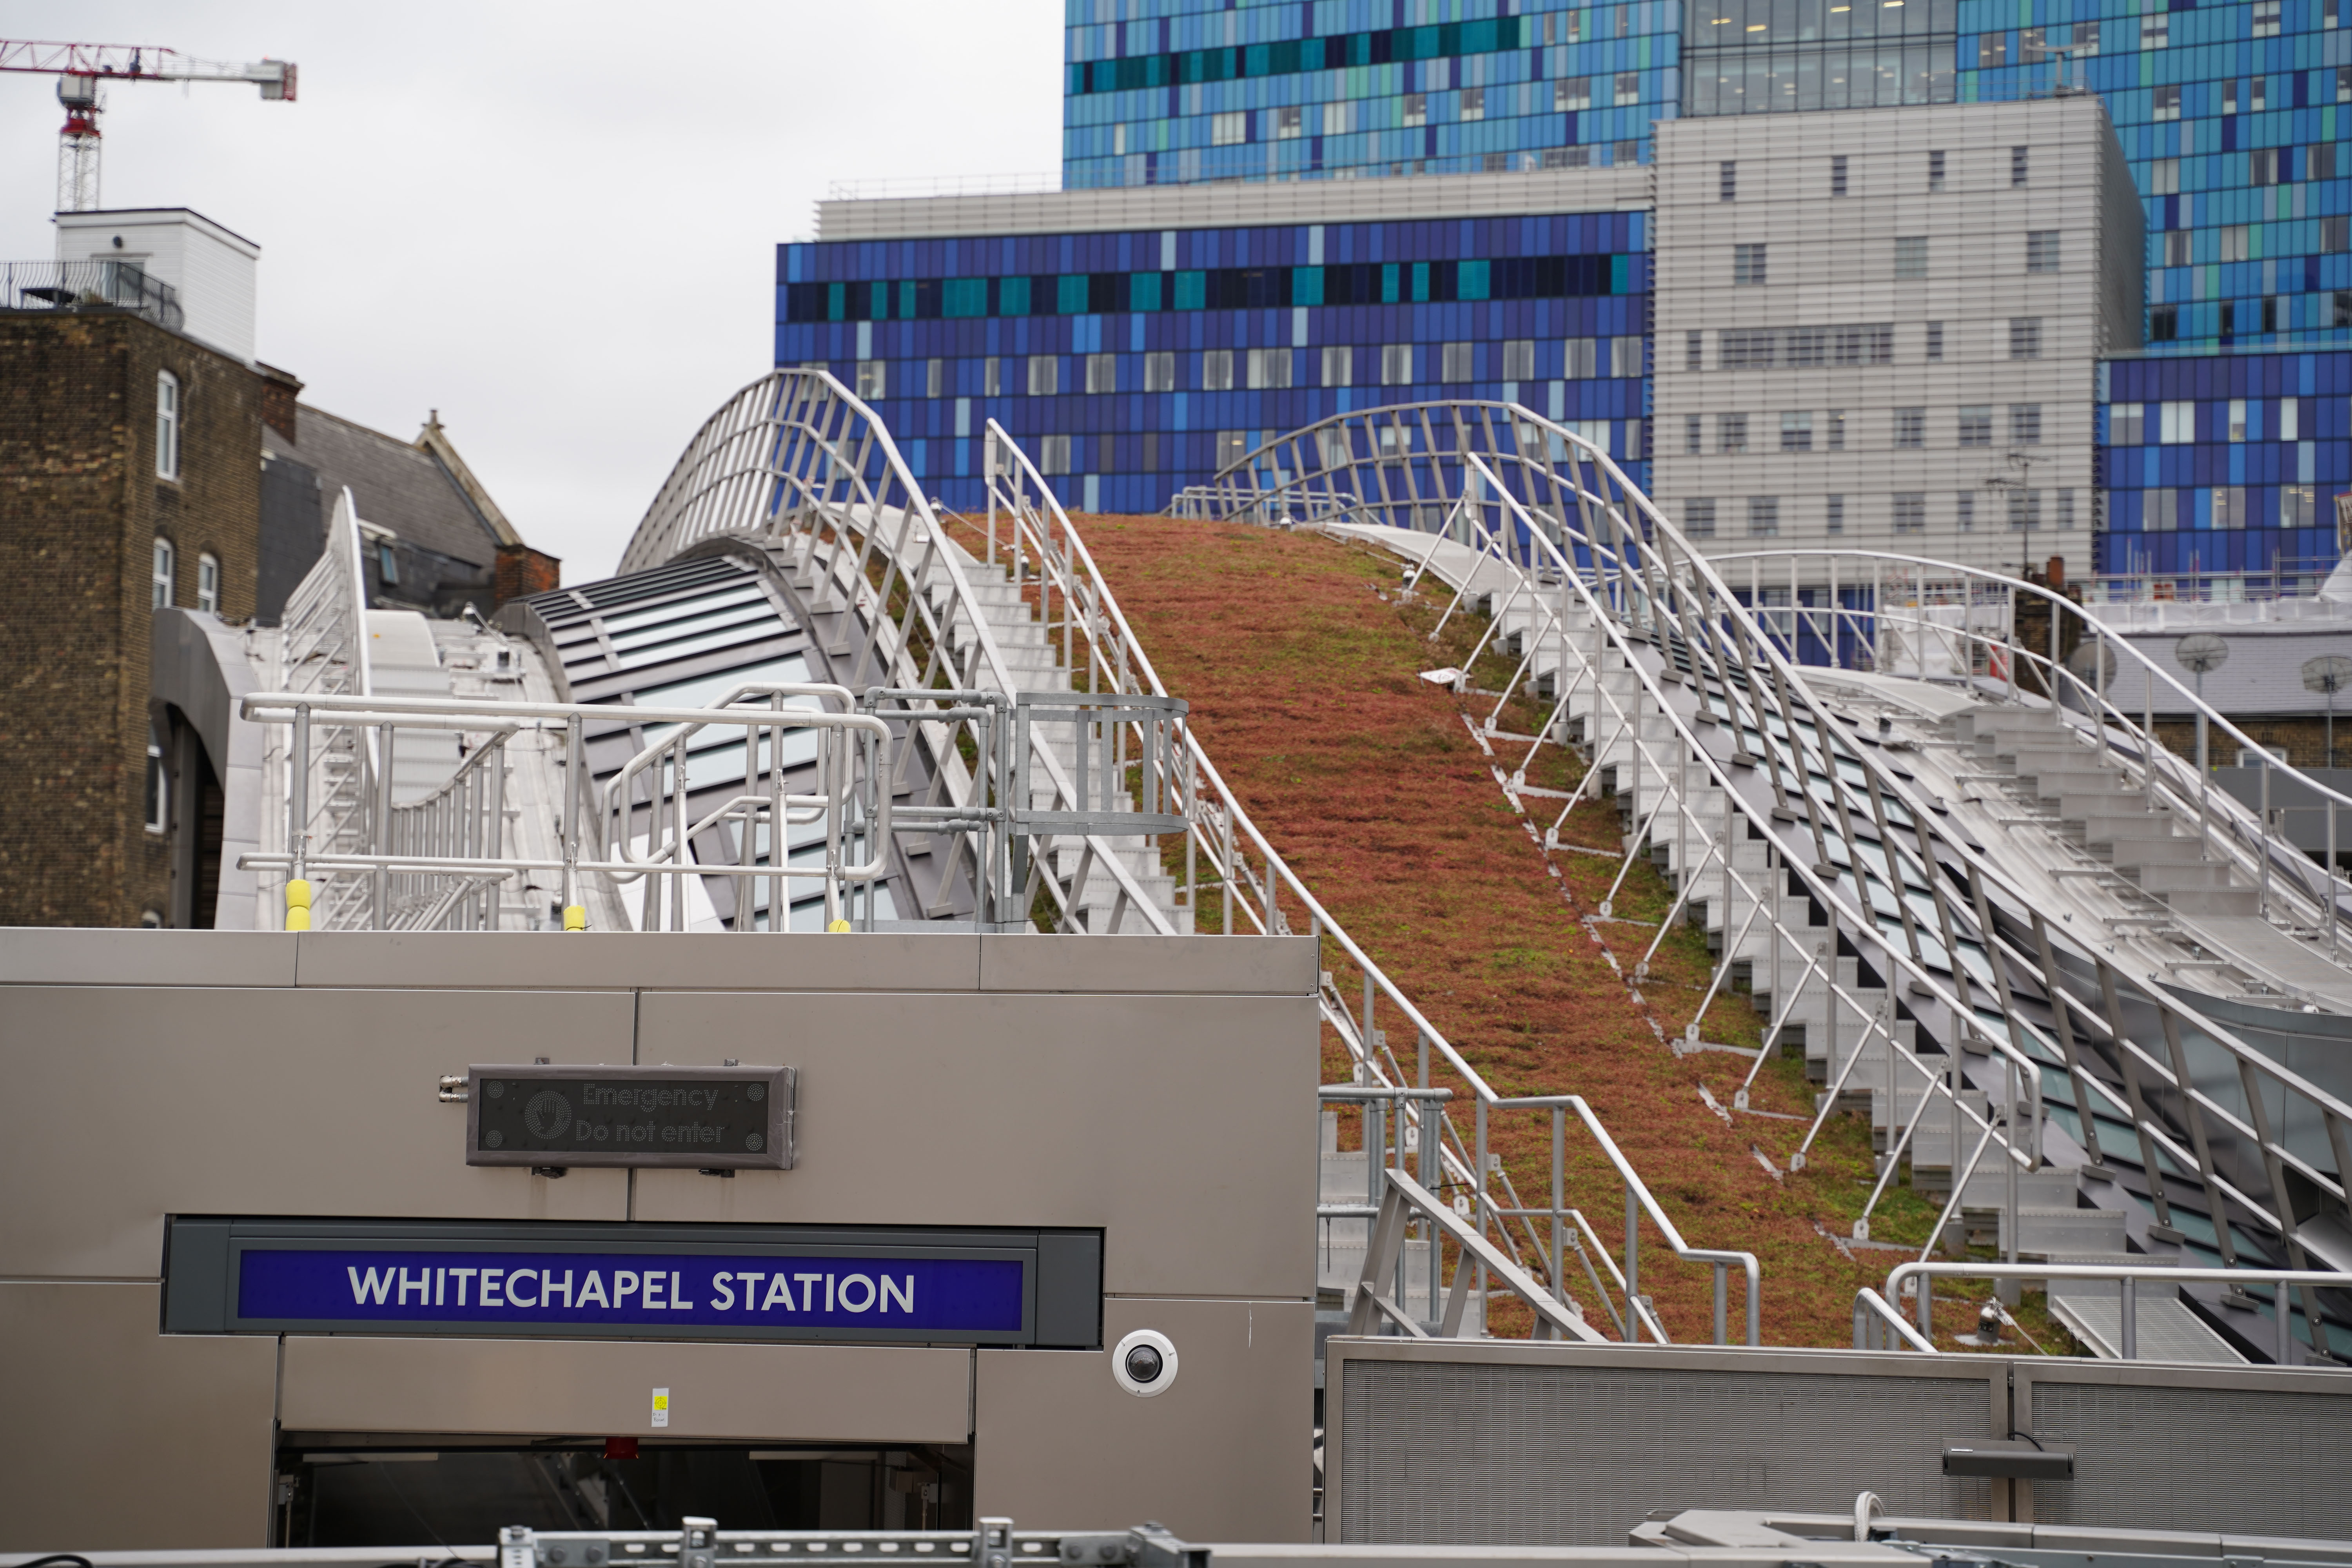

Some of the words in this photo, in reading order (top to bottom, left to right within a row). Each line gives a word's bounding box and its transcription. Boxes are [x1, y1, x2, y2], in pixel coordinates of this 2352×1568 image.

[583, 1083, 719, 1112] Emergency
[576, 1120, 608, 1141] Do
[616, 1120, 656, 1142] not
[661, 1121, 725, 1143] enter
[347, 1267, 693, 1309] WHITECHAPEL
[710, 1272, 914, 1313] STATION
